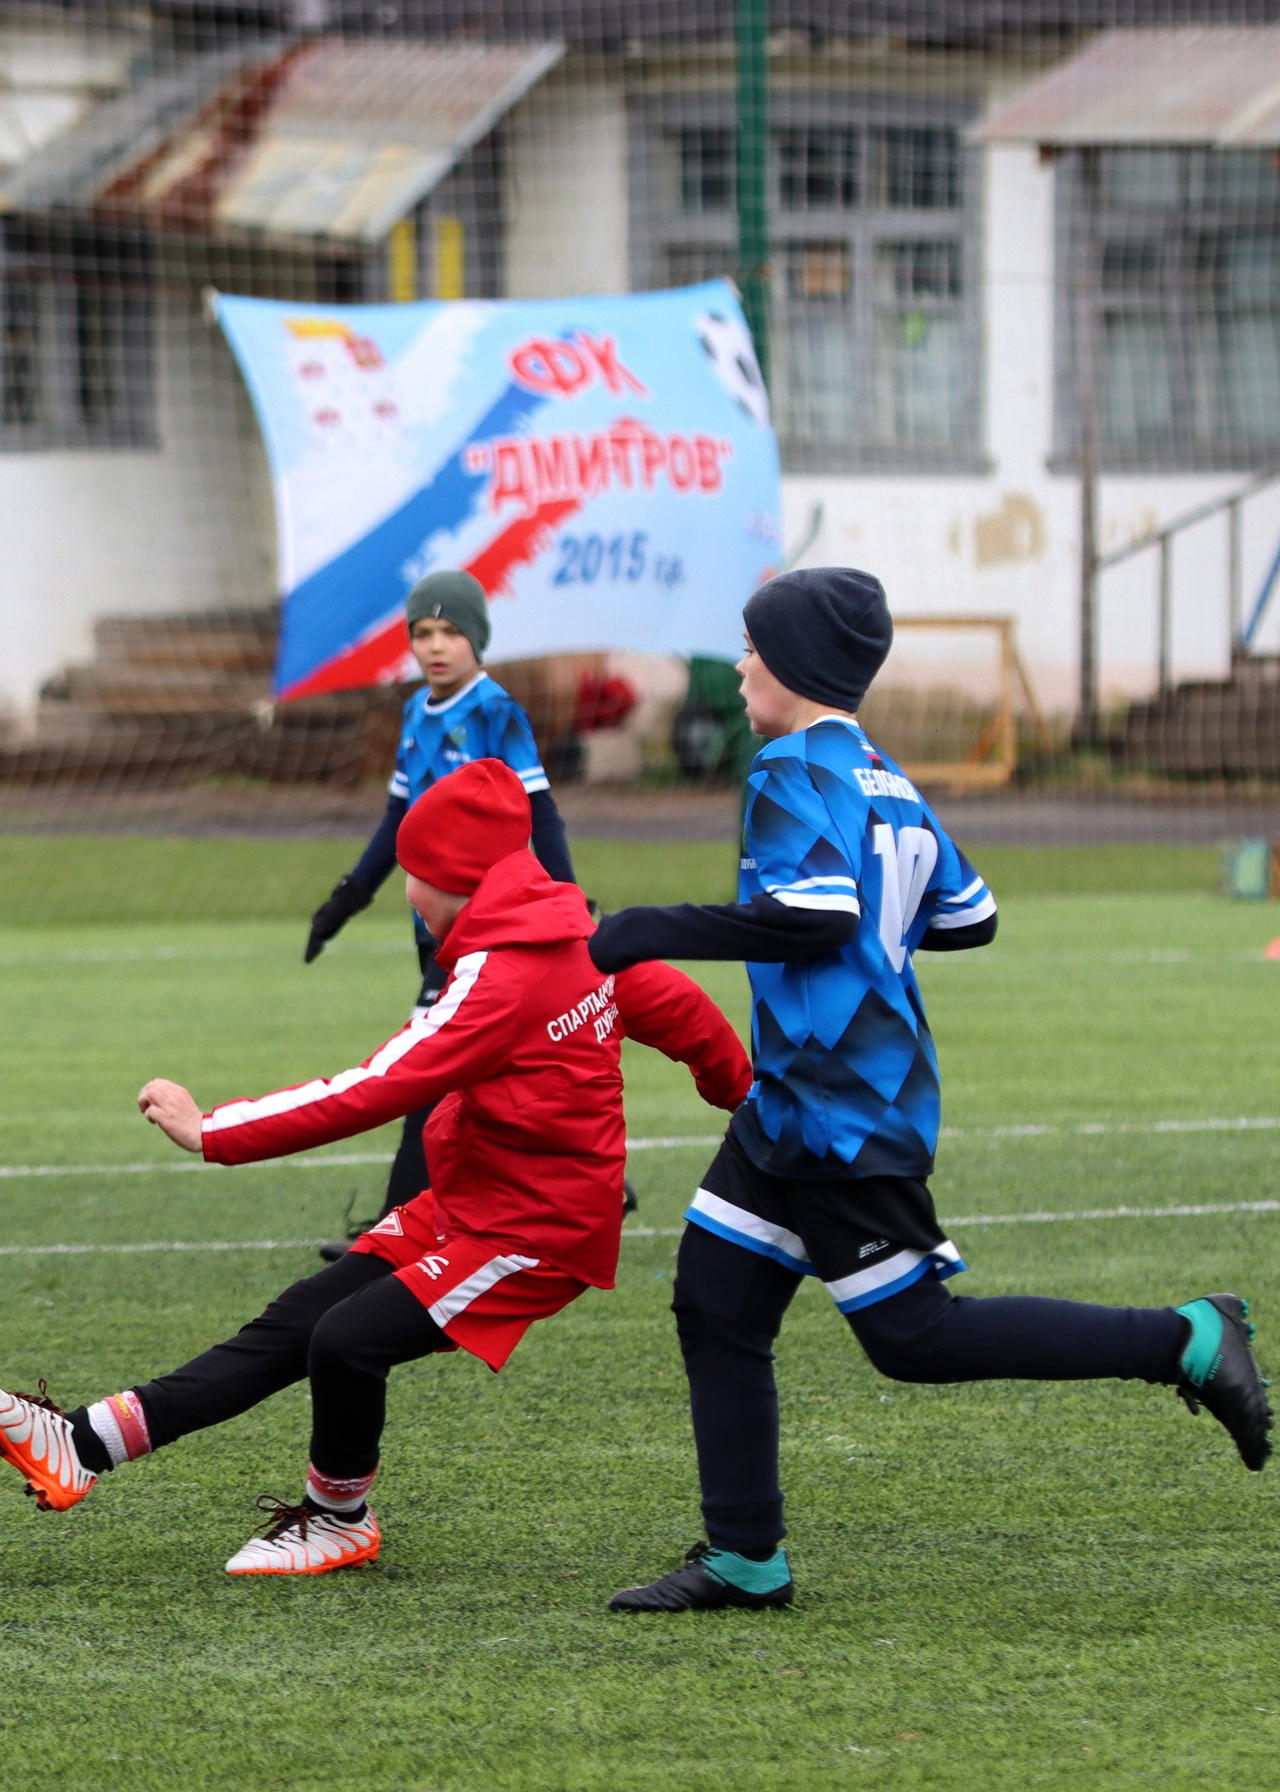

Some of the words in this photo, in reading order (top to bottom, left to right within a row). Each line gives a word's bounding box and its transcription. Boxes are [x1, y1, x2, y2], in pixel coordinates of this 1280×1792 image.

[511, 330, 650, 399] ФК
[464, 420, 731, 516] "ДМИТРОВ"
[553, 531, 648, 587] 2015
[873, 822, 939, 974] 10
